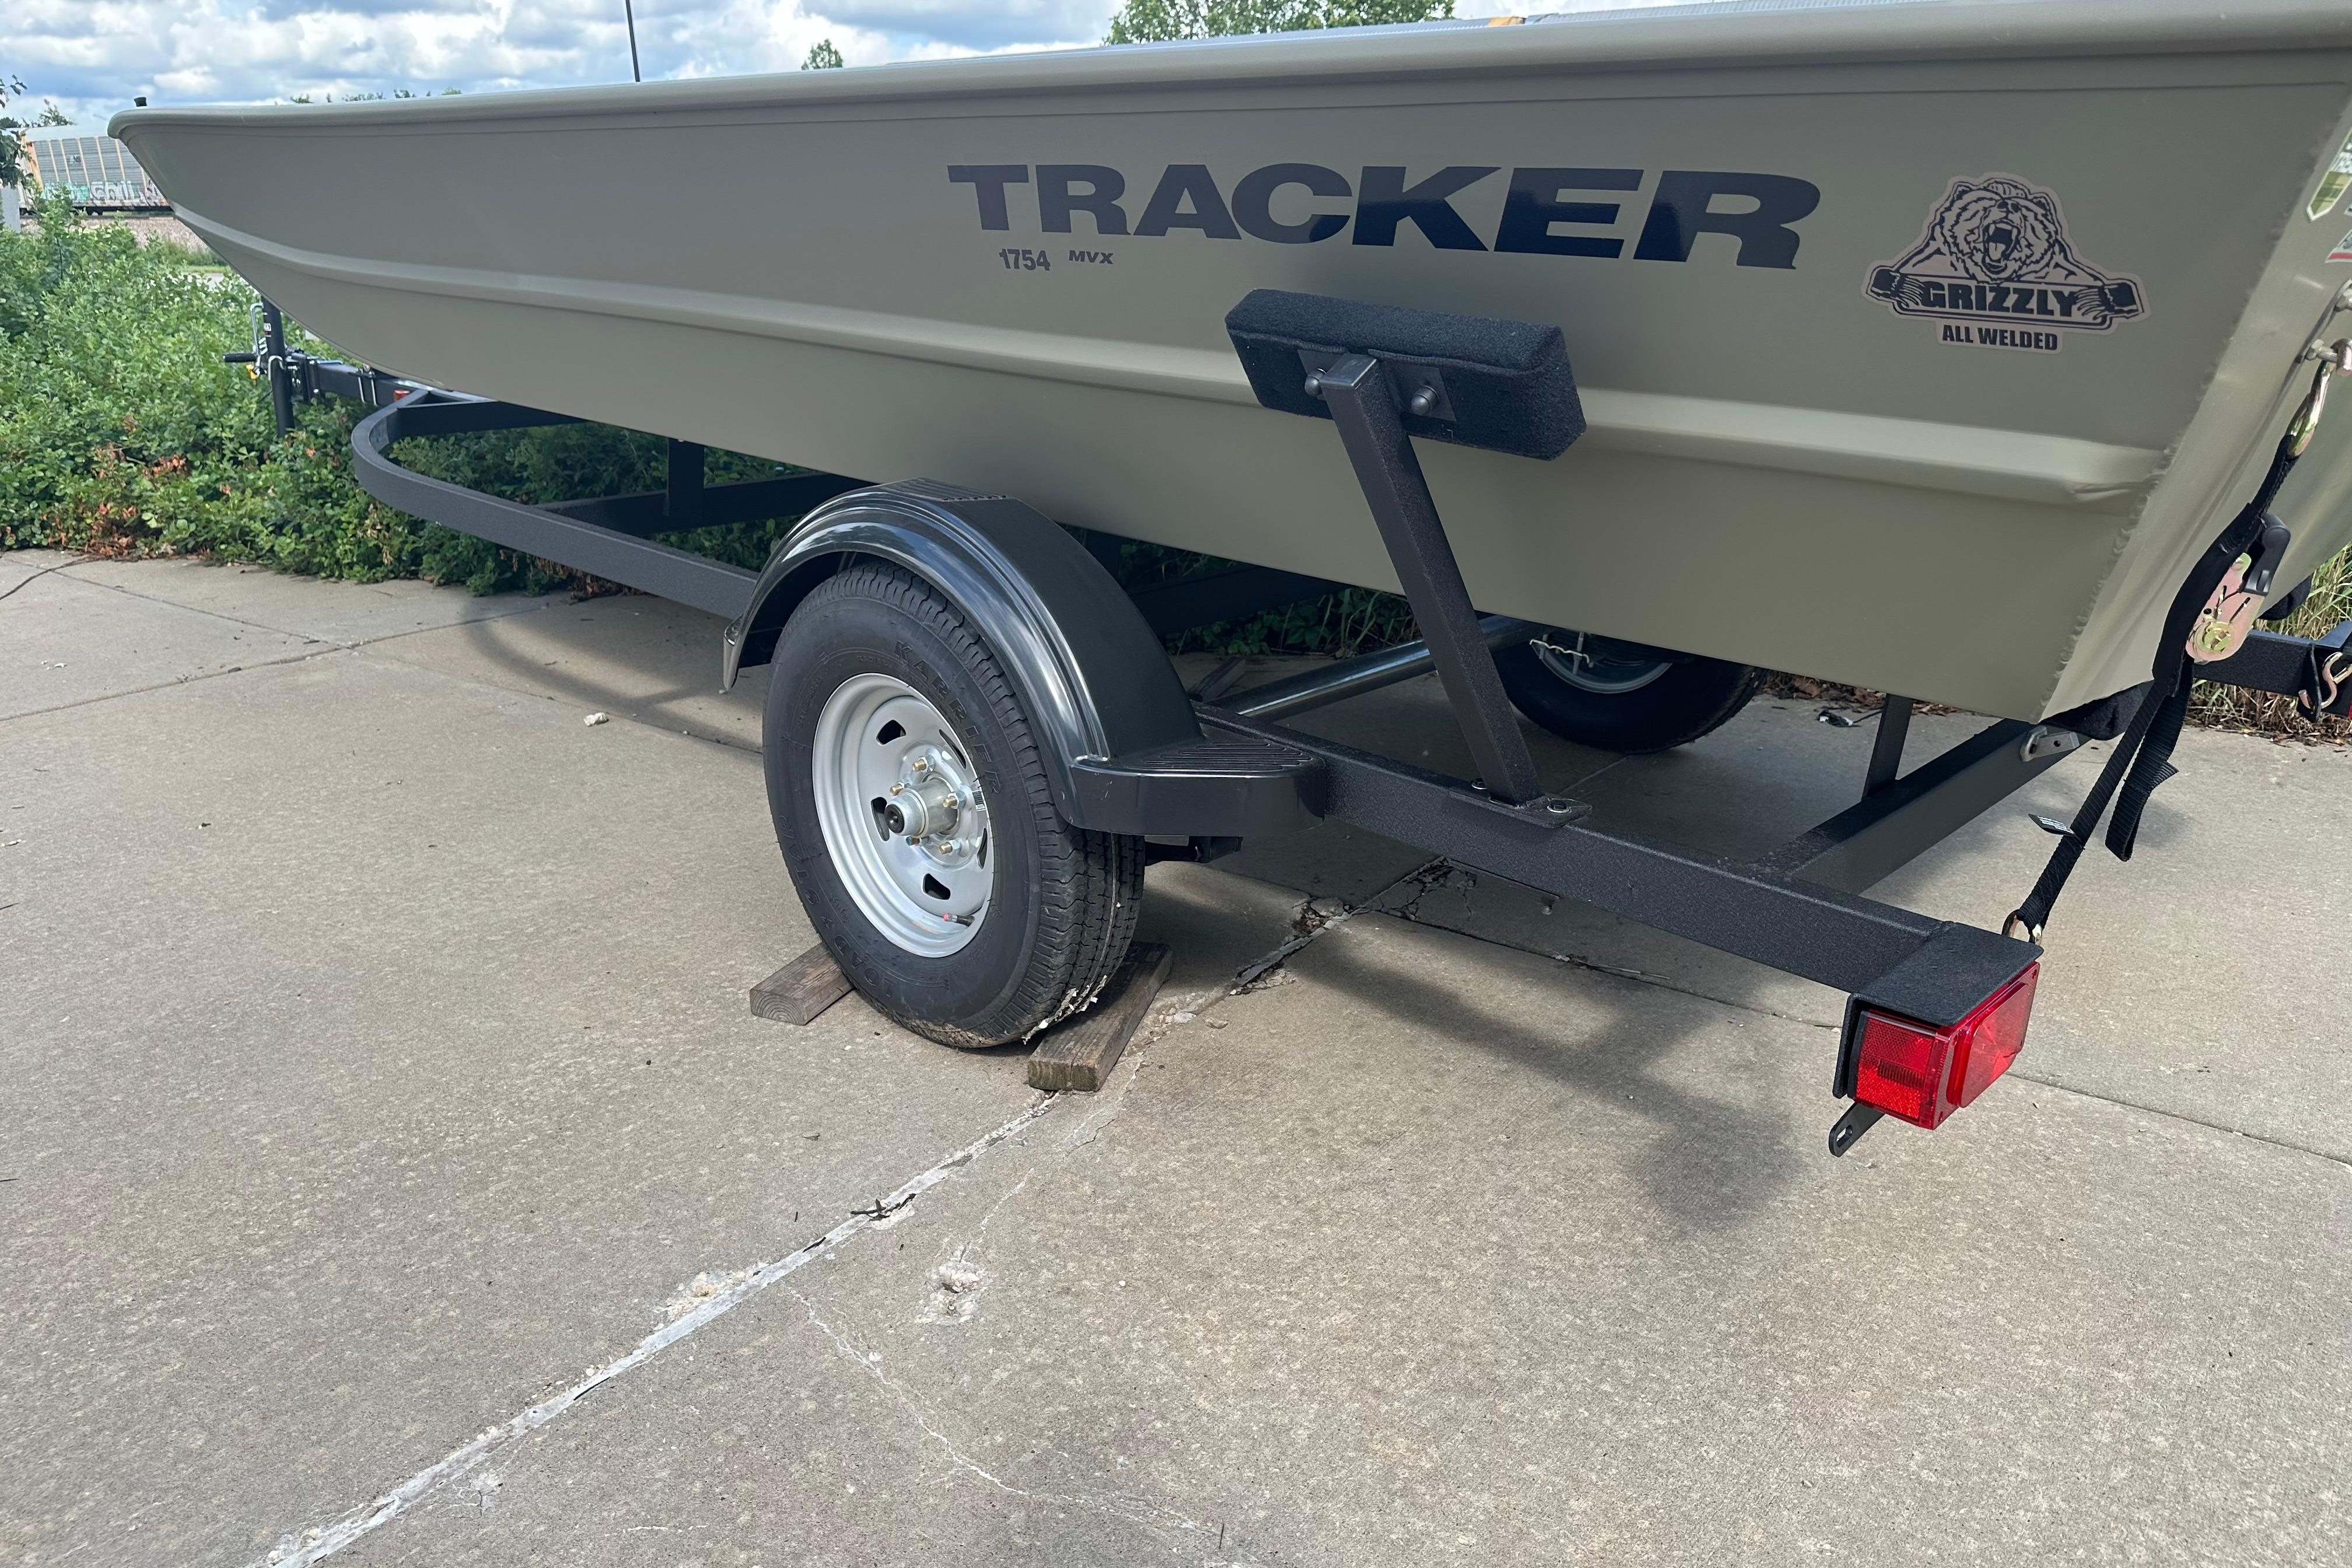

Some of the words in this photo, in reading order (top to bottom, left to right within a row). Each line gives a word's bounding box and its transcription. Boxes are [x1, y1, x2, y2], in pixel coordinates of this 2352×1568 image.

[947, 163, 1821, 270] TRACKER
[999, 249, 1051, 271] 1754
[1069, 250, 1114, 264] MVX
[1921, 281, 2076, 317] GRIZZLY
[1942, 324, 1973, 343] ALL
[1978, 327, 2057, 351] WELDED
[894, 640, 1001, 794] KARRIER
[779, 815, 821, 905] STAR
[834, 935, 898, 998] LOAD
